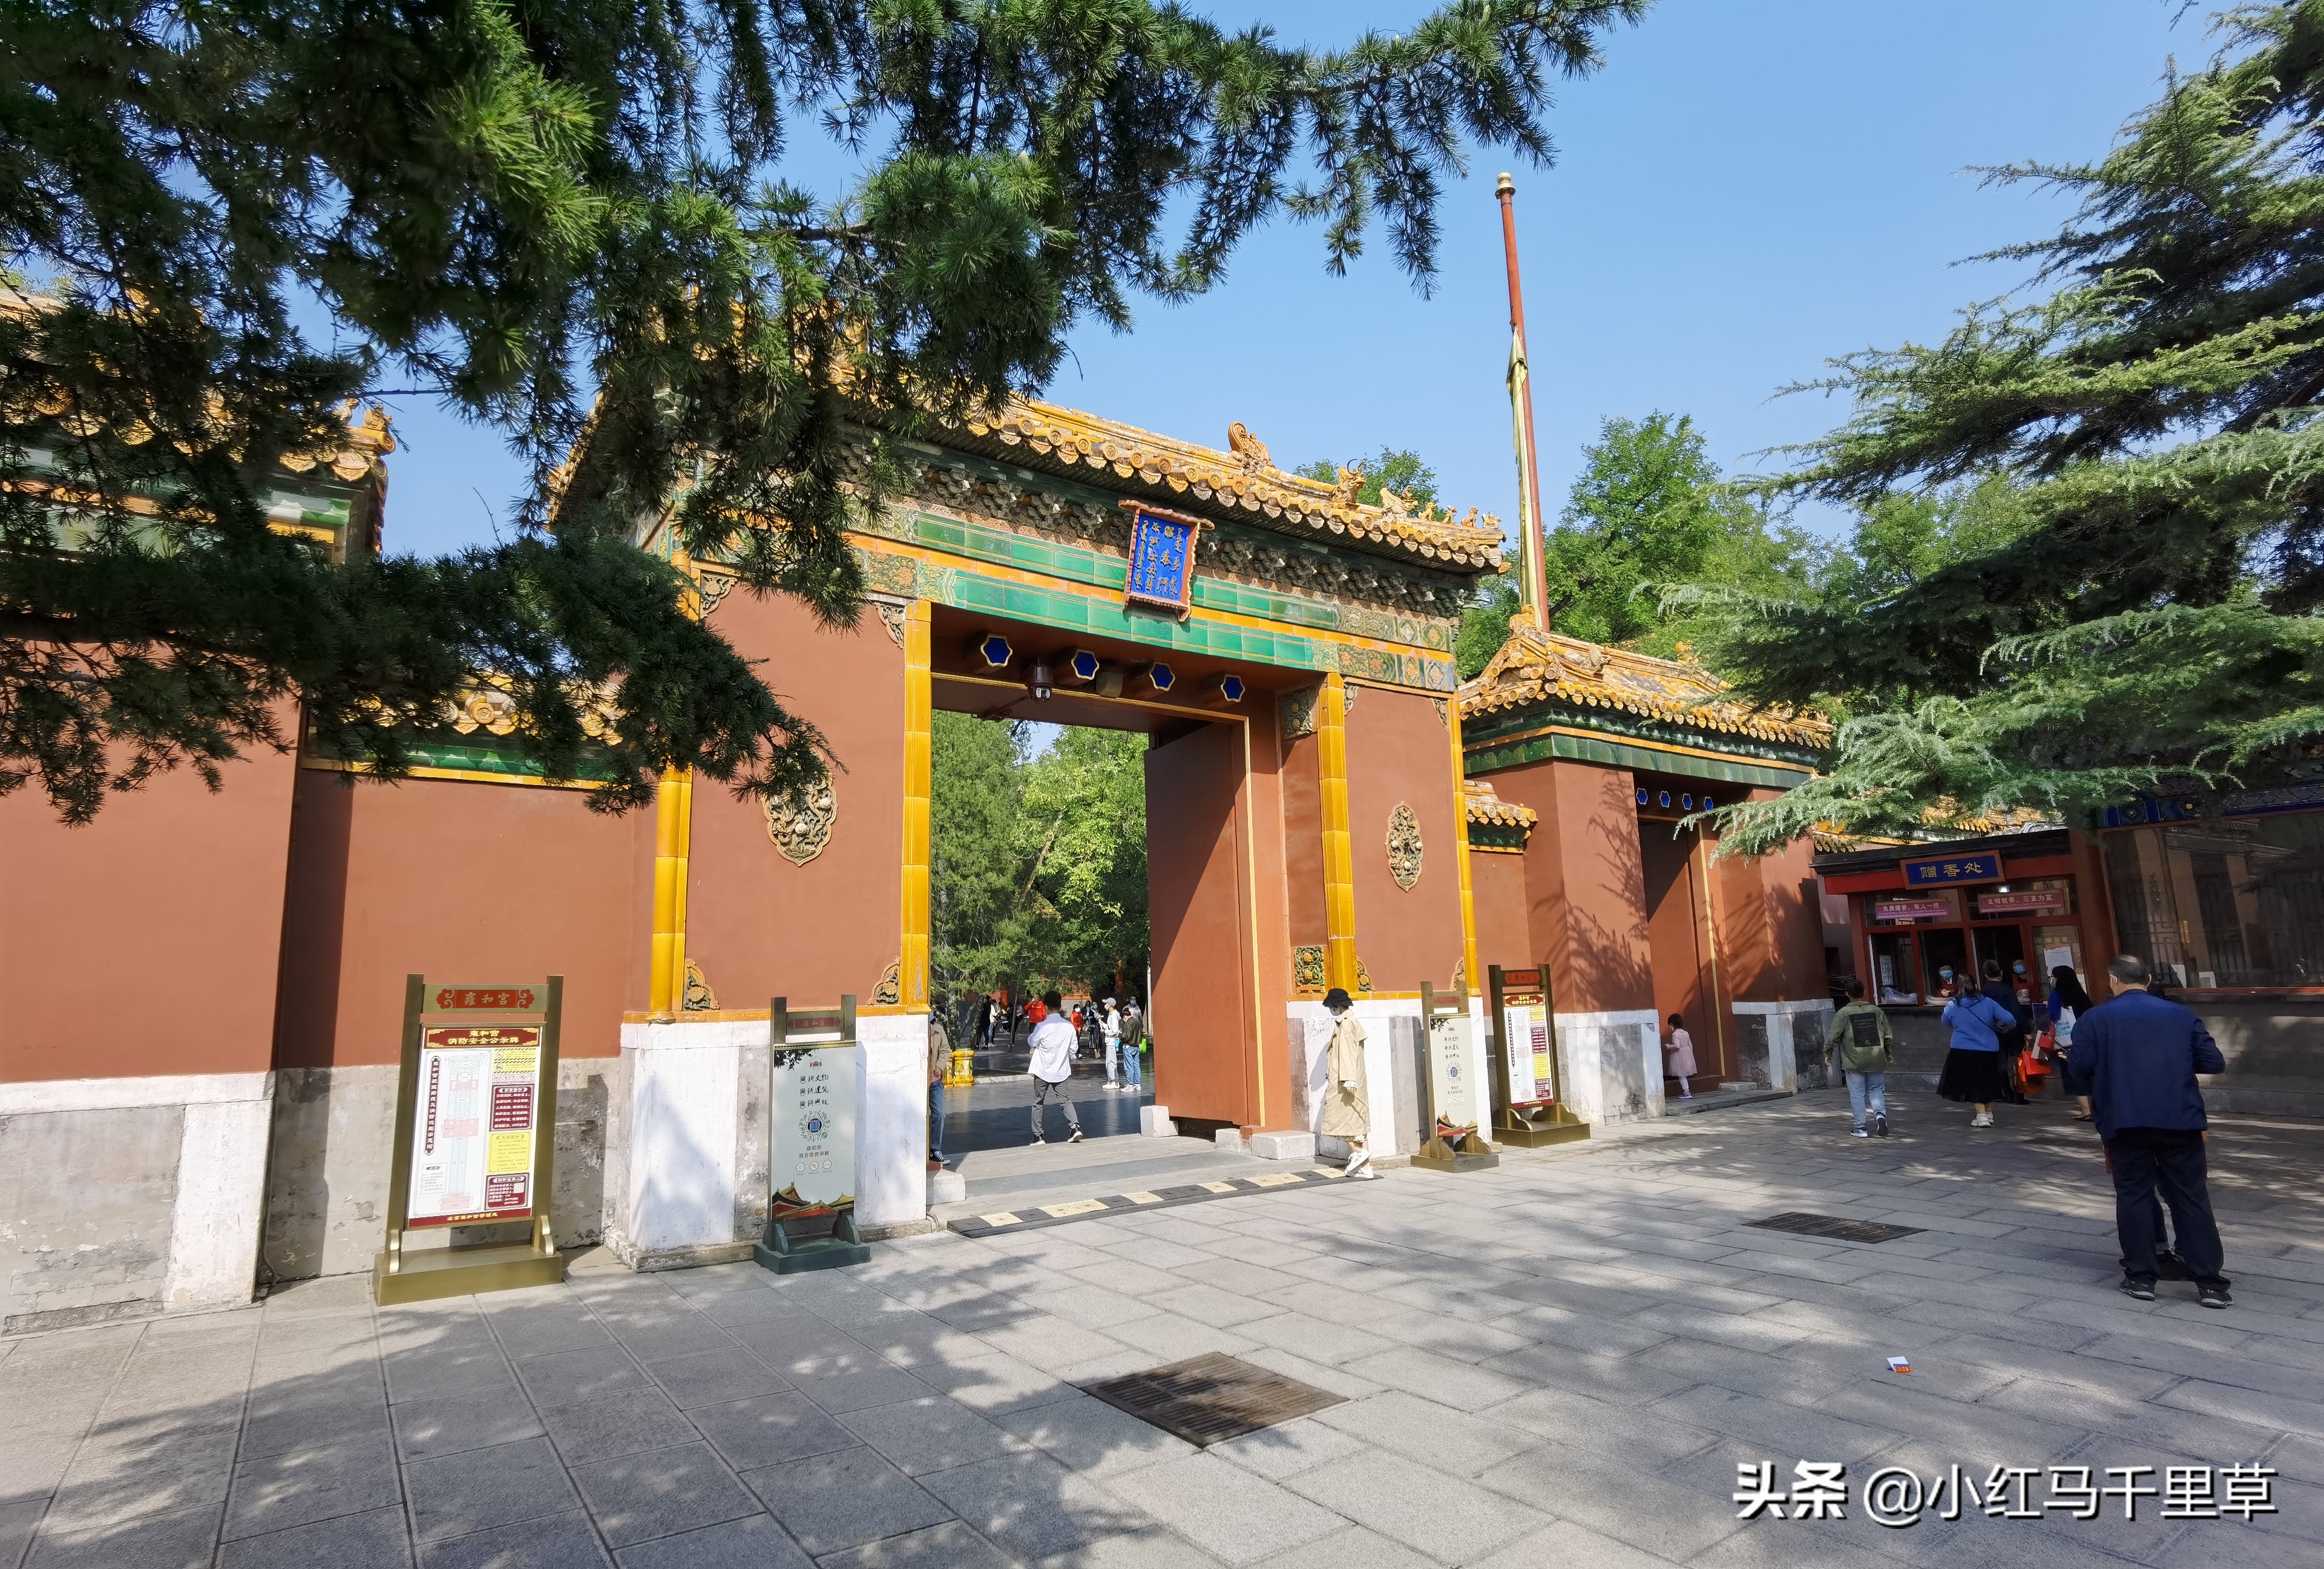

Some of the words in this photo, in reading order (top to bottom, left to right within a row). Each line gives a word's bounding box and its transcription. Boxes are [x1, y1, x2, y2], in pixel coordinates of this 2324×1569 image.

[1920, 861, 1983, 878] 赠香处
[464, 992, 510, 1006] 雍和宫
